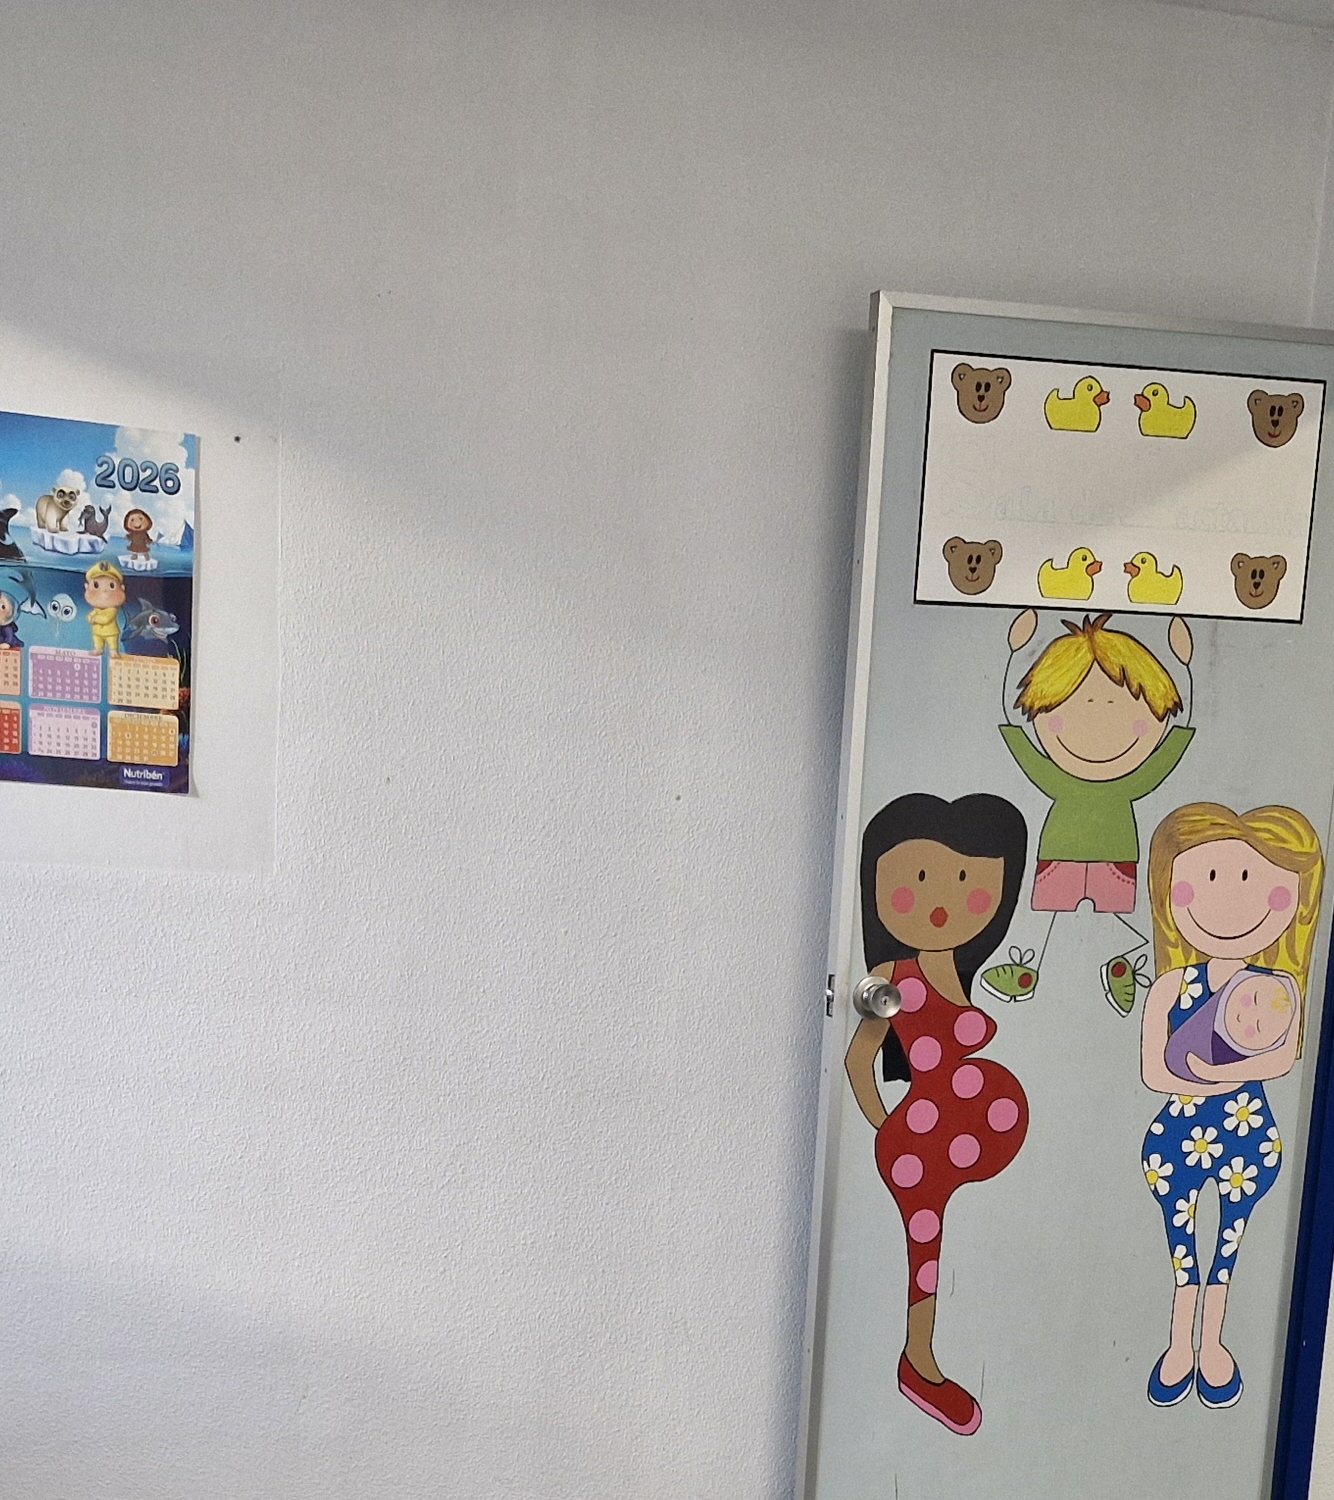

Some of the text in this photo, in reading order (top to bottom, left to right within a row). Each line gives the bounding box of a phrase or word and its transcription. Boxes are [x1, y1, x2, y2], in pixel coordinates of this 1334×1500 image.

[94, 455, 181, 495] 2026
[55, 649, 76, 657] MAYO
[123, 767, 163, 780] Nutribén
